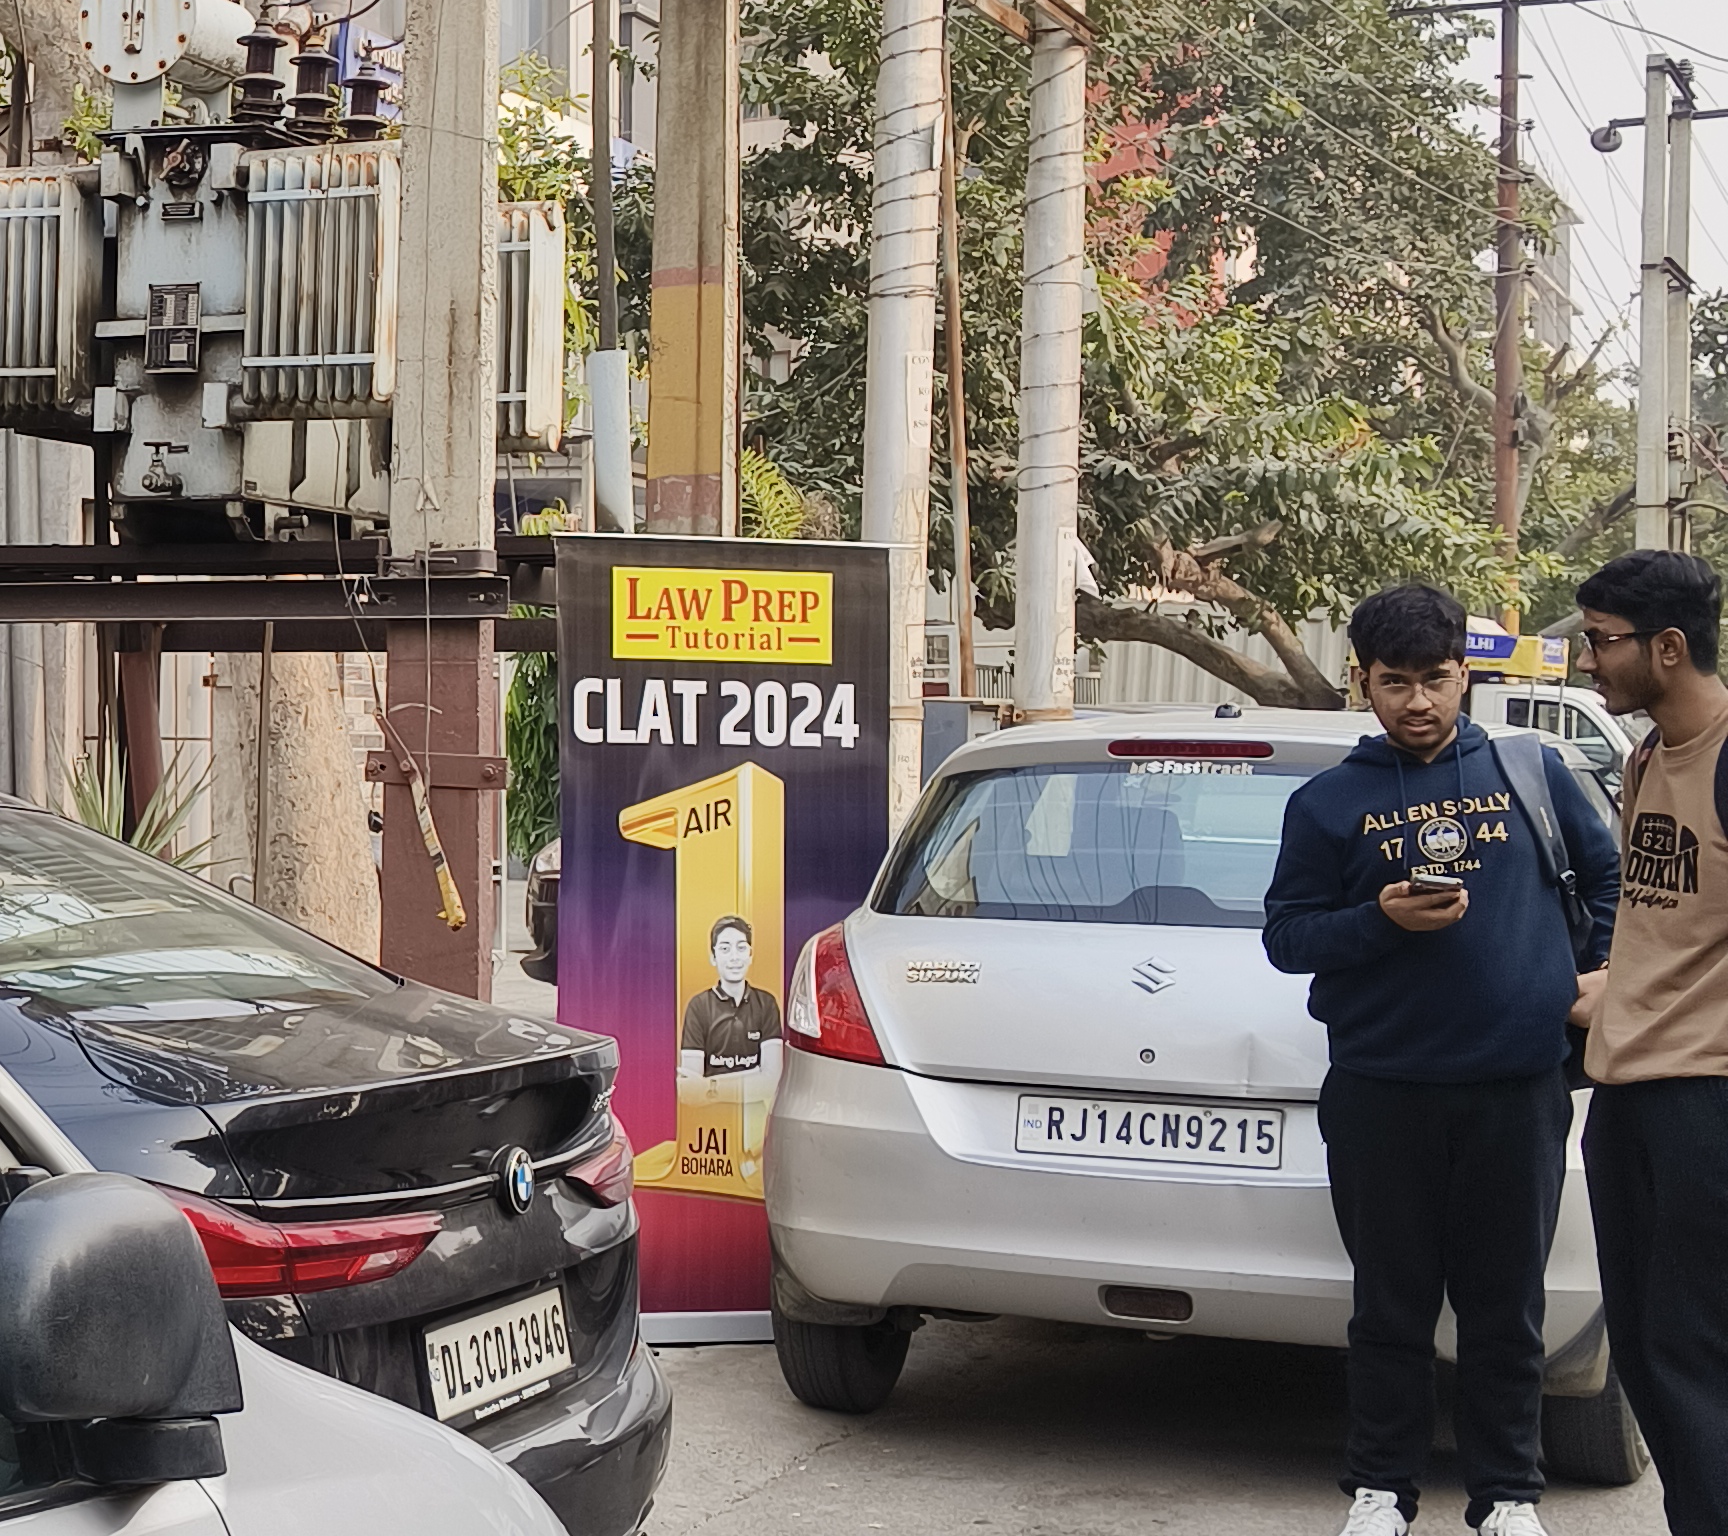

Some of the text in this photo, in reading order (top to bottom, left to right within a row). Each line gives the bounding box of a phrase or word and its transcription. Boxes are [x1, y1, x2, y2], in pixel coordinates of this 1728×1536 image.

[626, 577, 820, 624] LAW PREP
[666, 625, 783, 651] Tutorial
[573, 676, 860, 749] CLAT 2024
[683, 798, 732, 839] AIR
[1363, 791, 1511, 835] ALLEN SOLLY
[1380, 837, 1404, 861] 17
[1475, 820, 1510, 844] 44
[1453, 858, 1482, 873] 1744
[906, 970, 979, 984] SUZUKI
[688, 1126, 727, 1155] JAI
[1022, 1106, 1275, 1155] IND RJ14CN9215
[681, 1156, 734, 1177] BOHARA
[440, 1304, 565, 1400] DL3CDA3946
